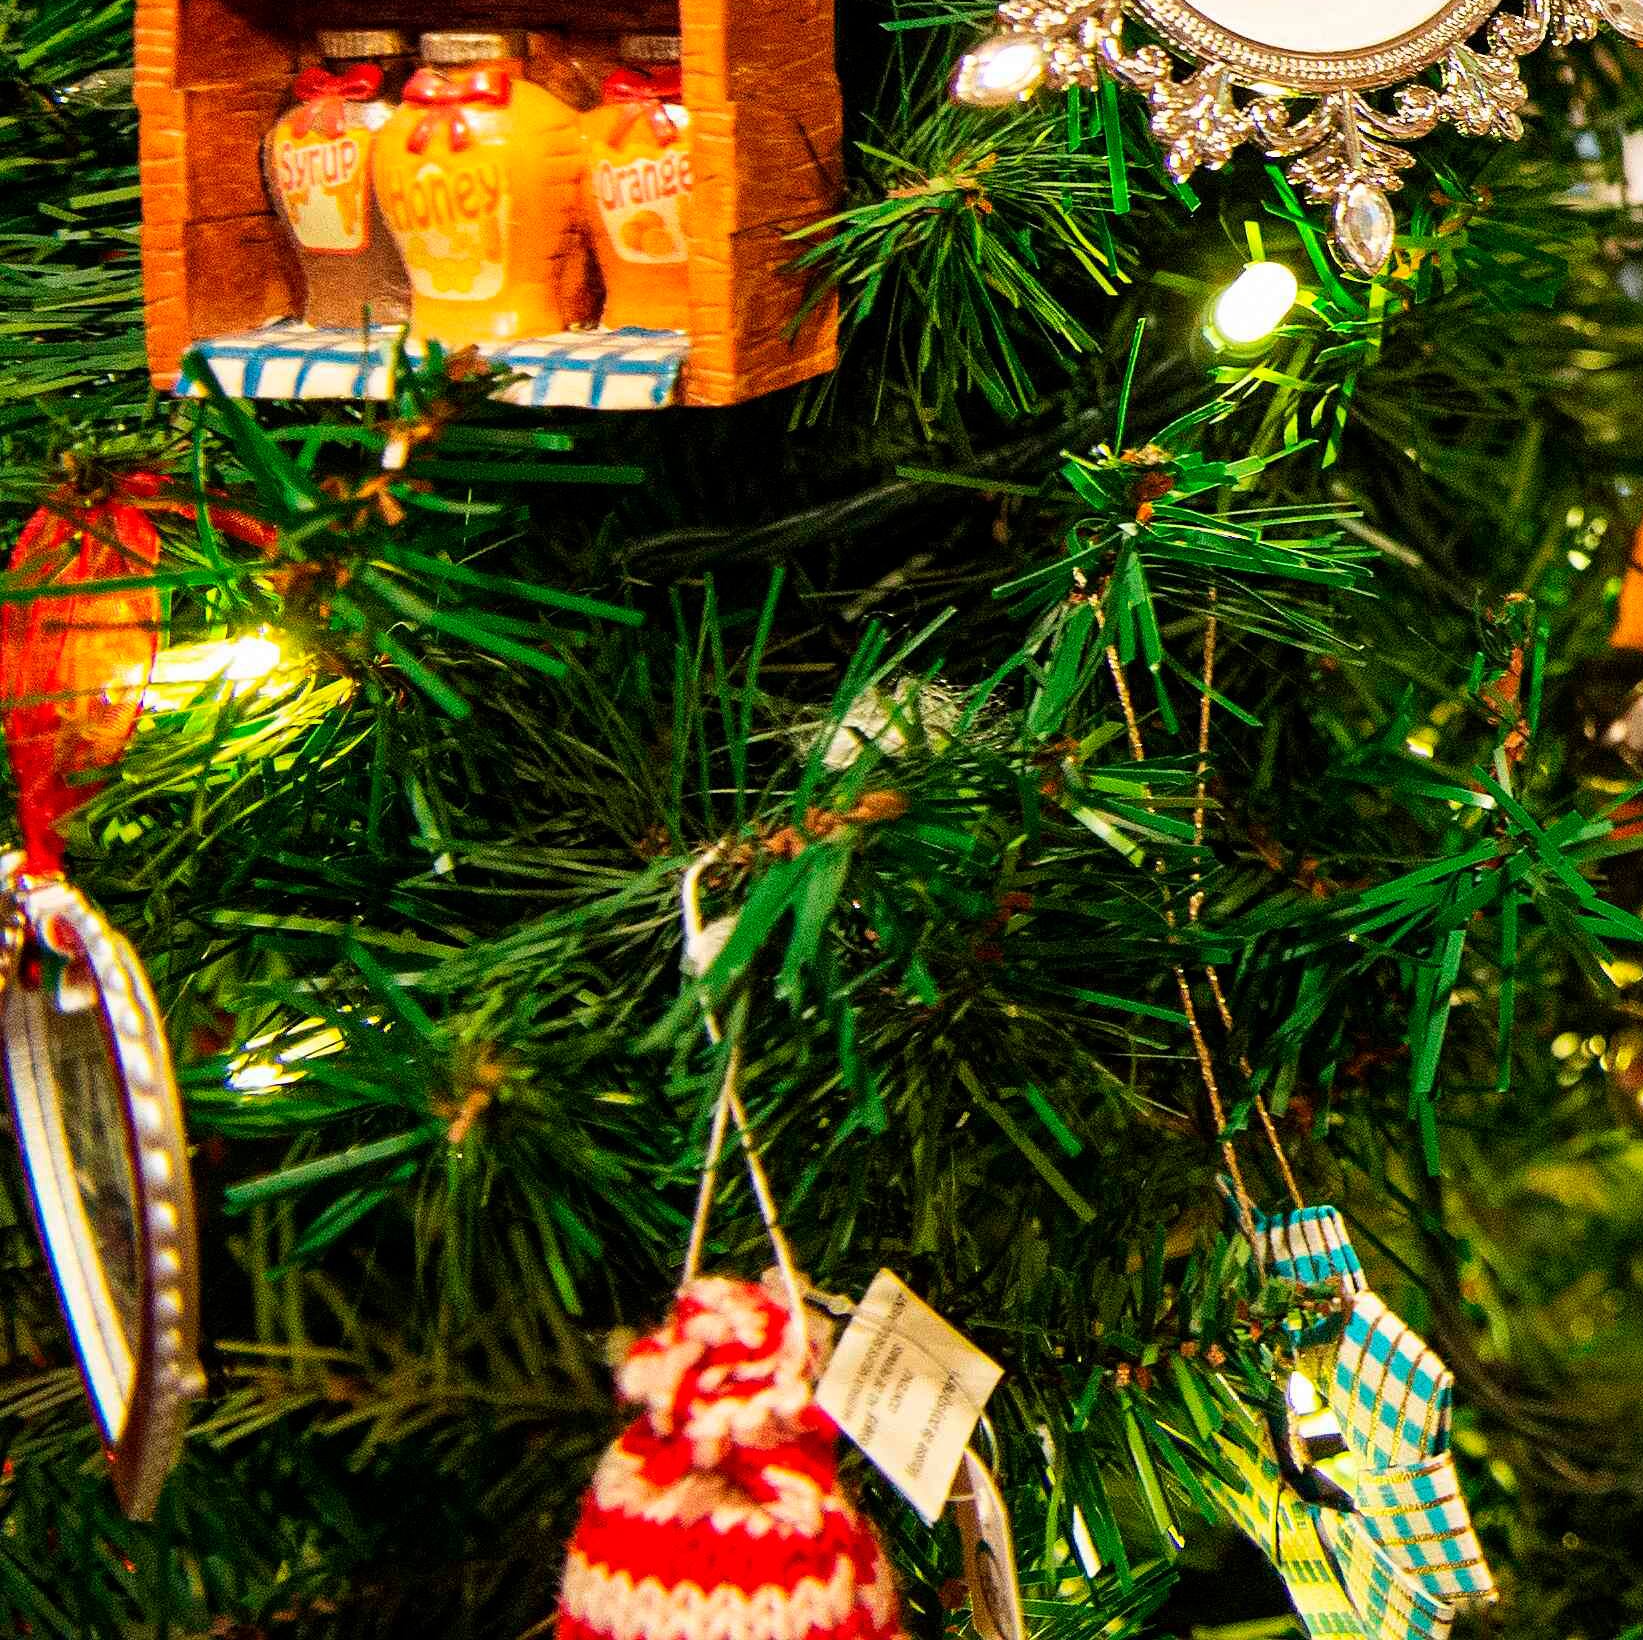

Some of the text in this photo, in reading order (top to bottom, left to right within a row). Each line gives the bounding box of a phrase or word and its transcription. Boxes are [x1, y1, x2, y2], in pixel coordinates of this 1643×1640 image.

[280, 140, 357, 190] Syrup
[600, 153, 694, 210] Orange
[385, 163, 501, 231] Honey
